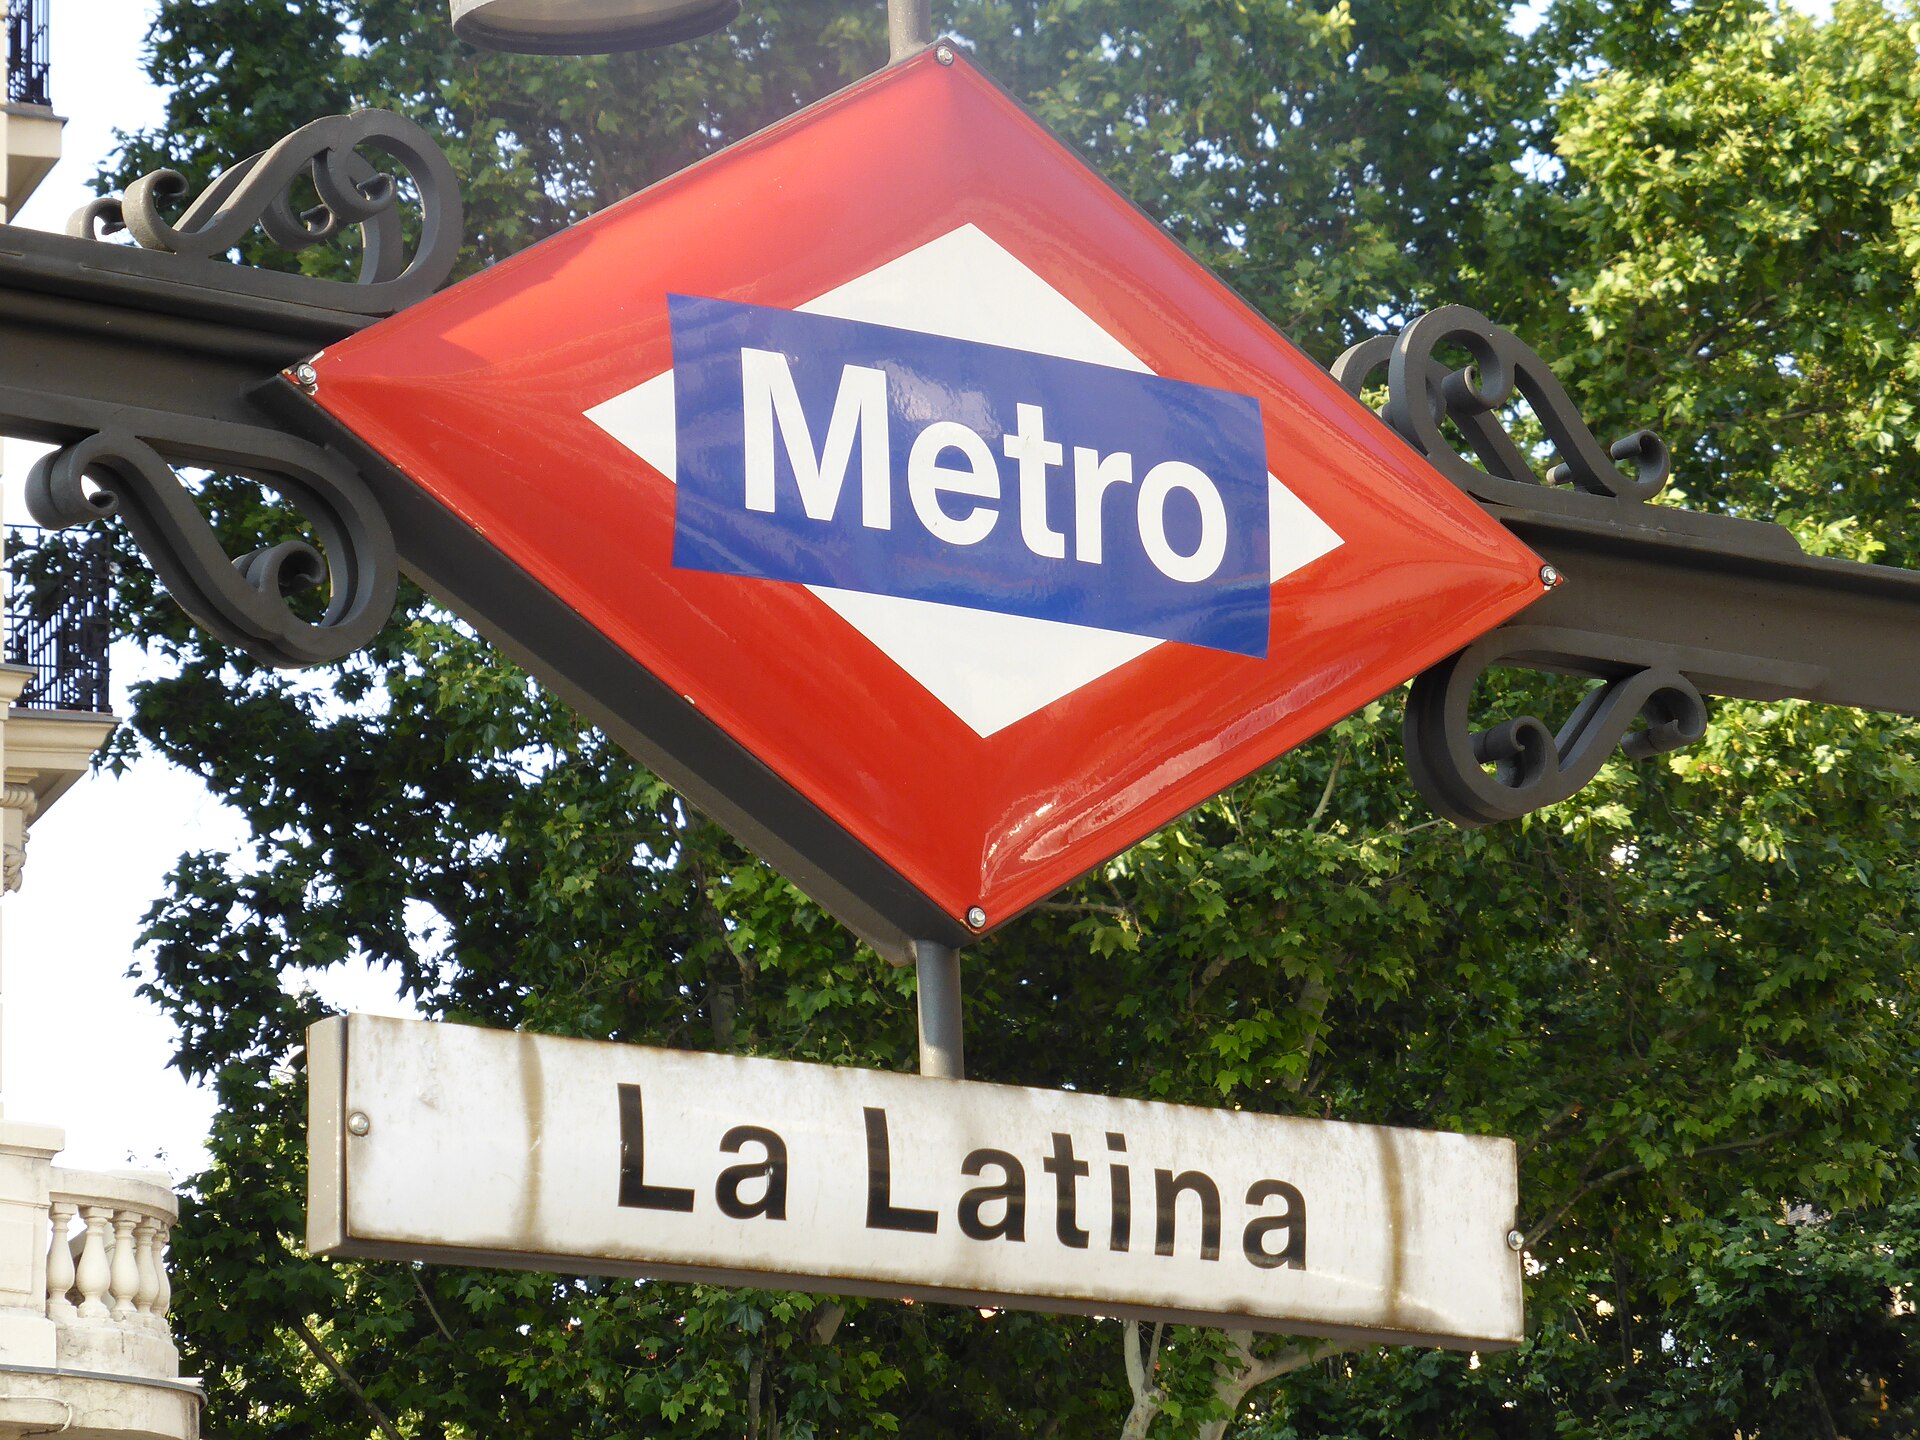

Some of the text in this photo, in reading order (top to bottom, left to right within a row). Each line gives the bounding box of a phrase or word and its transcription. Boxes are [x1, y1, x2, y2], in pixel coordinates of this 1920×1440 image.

[740, 346, 1228, 583] Metro
[618, 1083, 1307, 1270] La Latina
